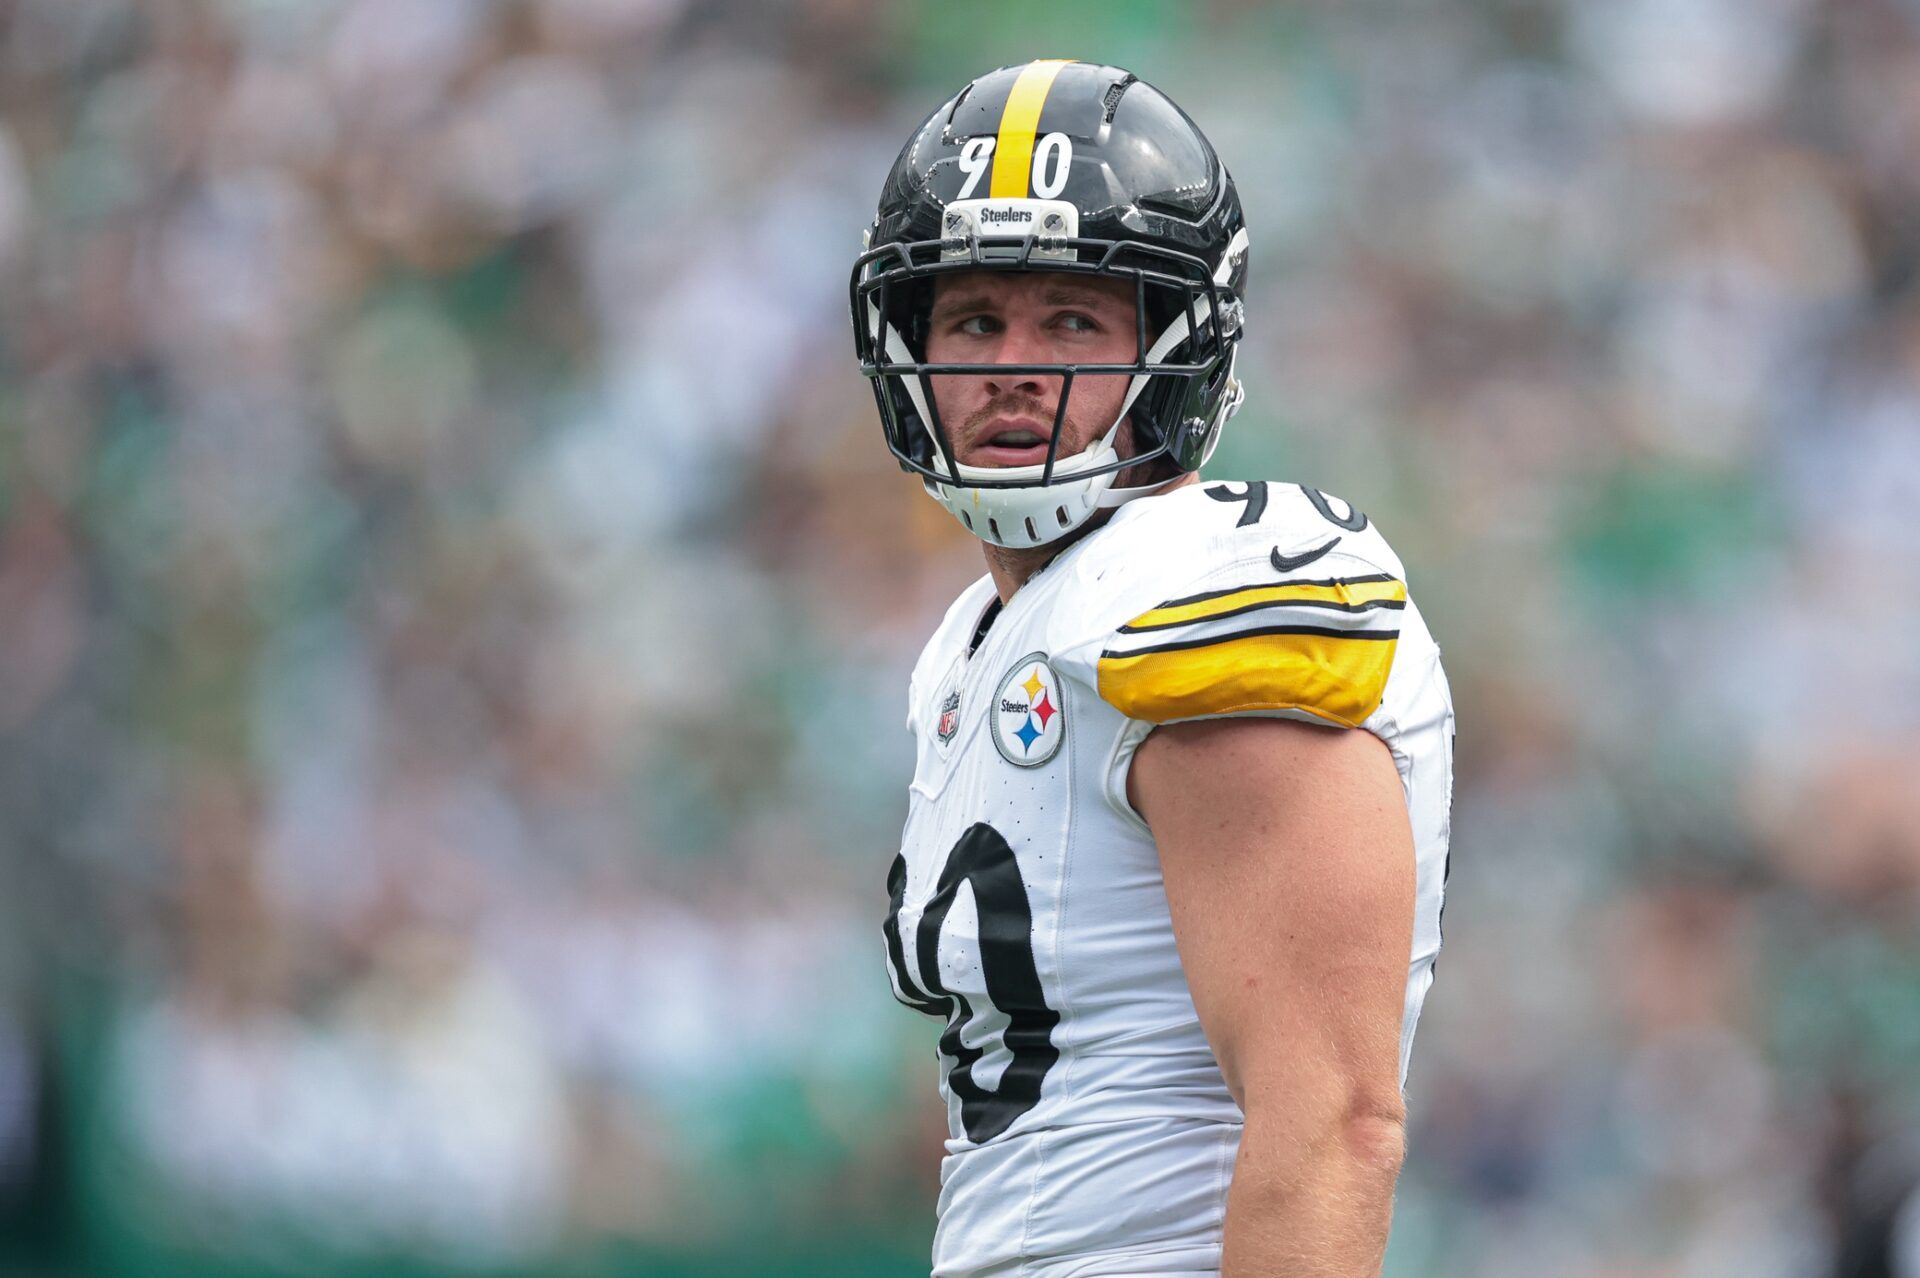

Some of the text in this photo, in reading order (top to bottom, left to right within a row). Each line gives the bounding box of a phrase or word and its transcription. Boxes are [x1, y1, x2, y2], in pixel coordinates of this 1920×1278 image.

[980, 206, 1032, 224] Steelers
[1000, 698, 1029, 714] Steelers
[939, 709, 957, 735] NFL
